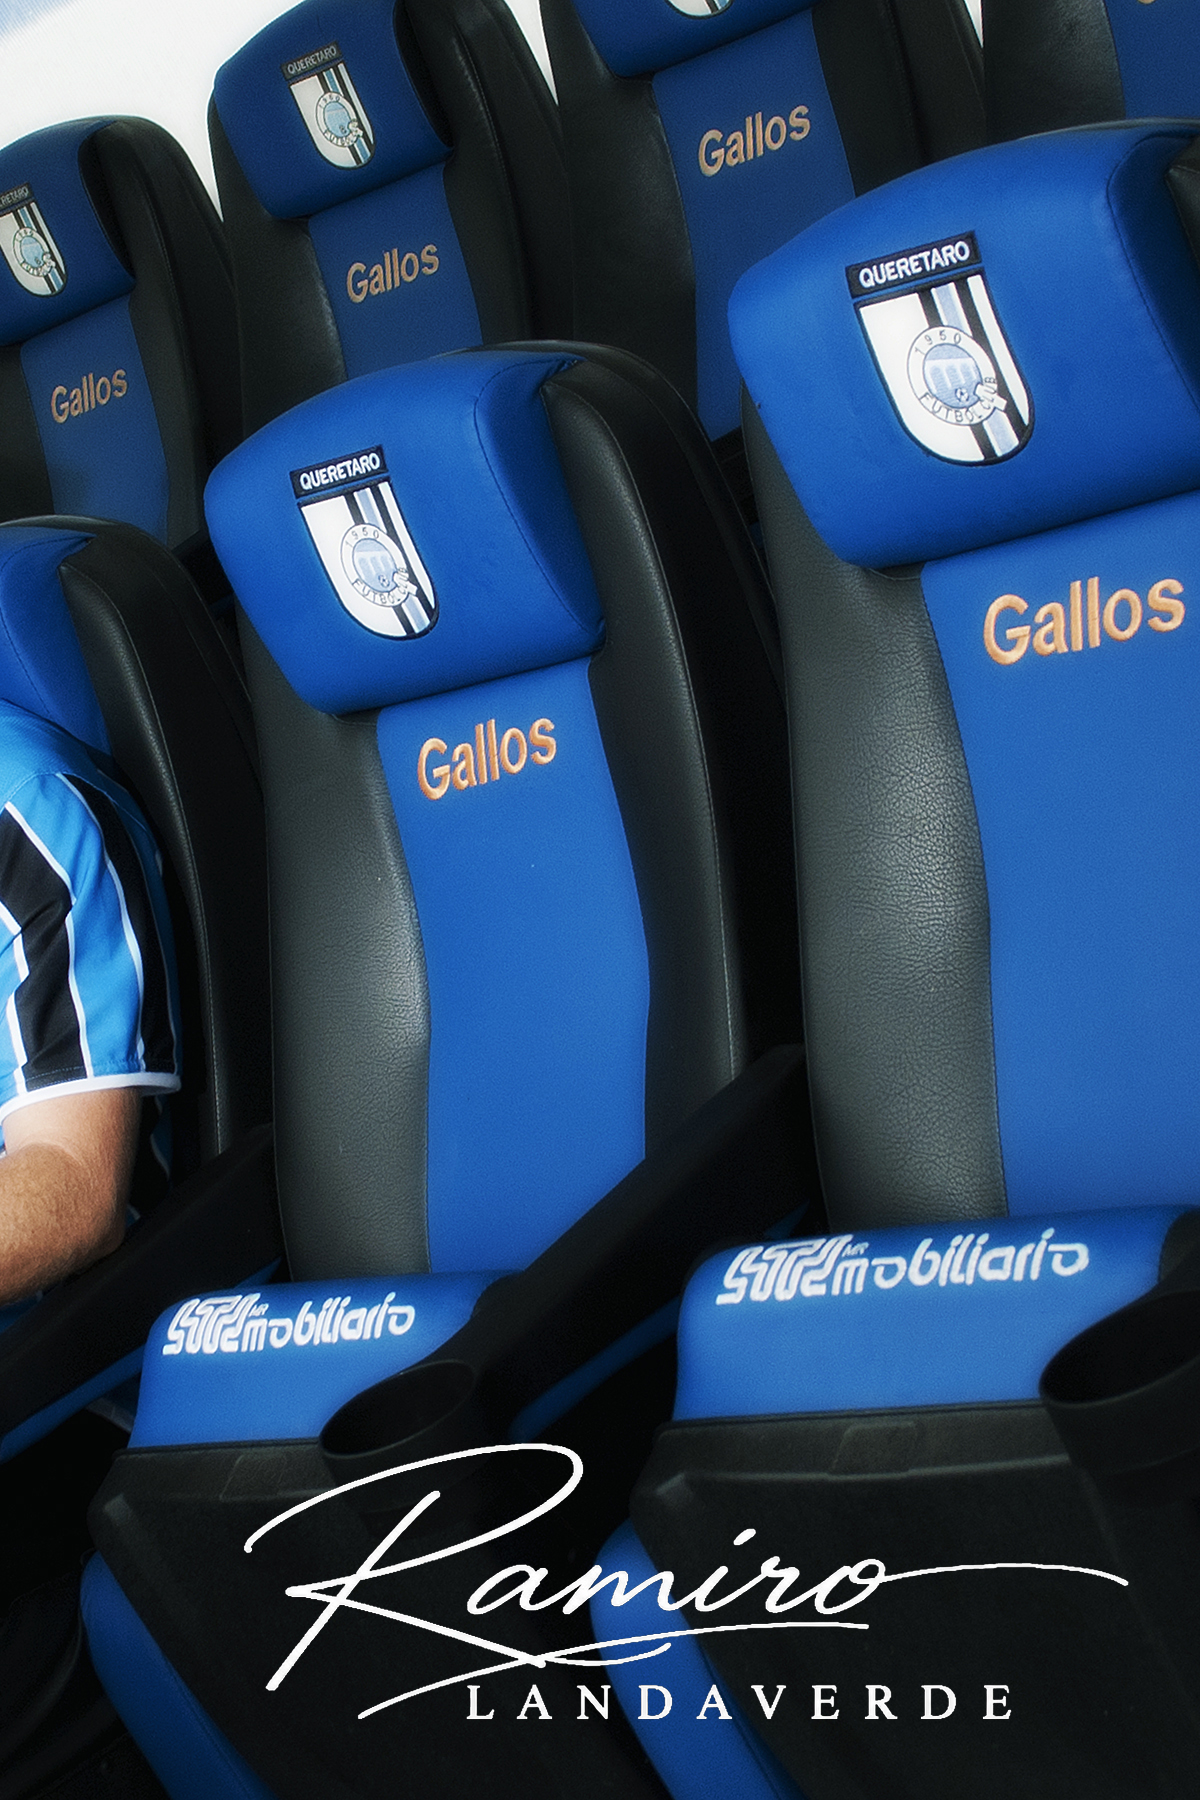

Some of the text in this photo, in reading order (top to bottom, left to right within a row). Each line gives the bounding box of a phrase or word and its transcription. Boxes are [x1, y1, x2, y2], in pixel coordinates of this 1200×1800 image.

[286, 45, 338, 75] QUERETARO
[697, 104, 811, 178] Gallos
[345, 238, 440, 304] Gallos
[858, 239, 971, 289] QUERETARO
[915, 329, 963, 356] 1950
[50, 368, 128, 424] Gallos
[299, 452, 381, 491] QUERETARO
[983, 577, 1187, 665] Gallos
[416, 717, 557, 800] Gallos
